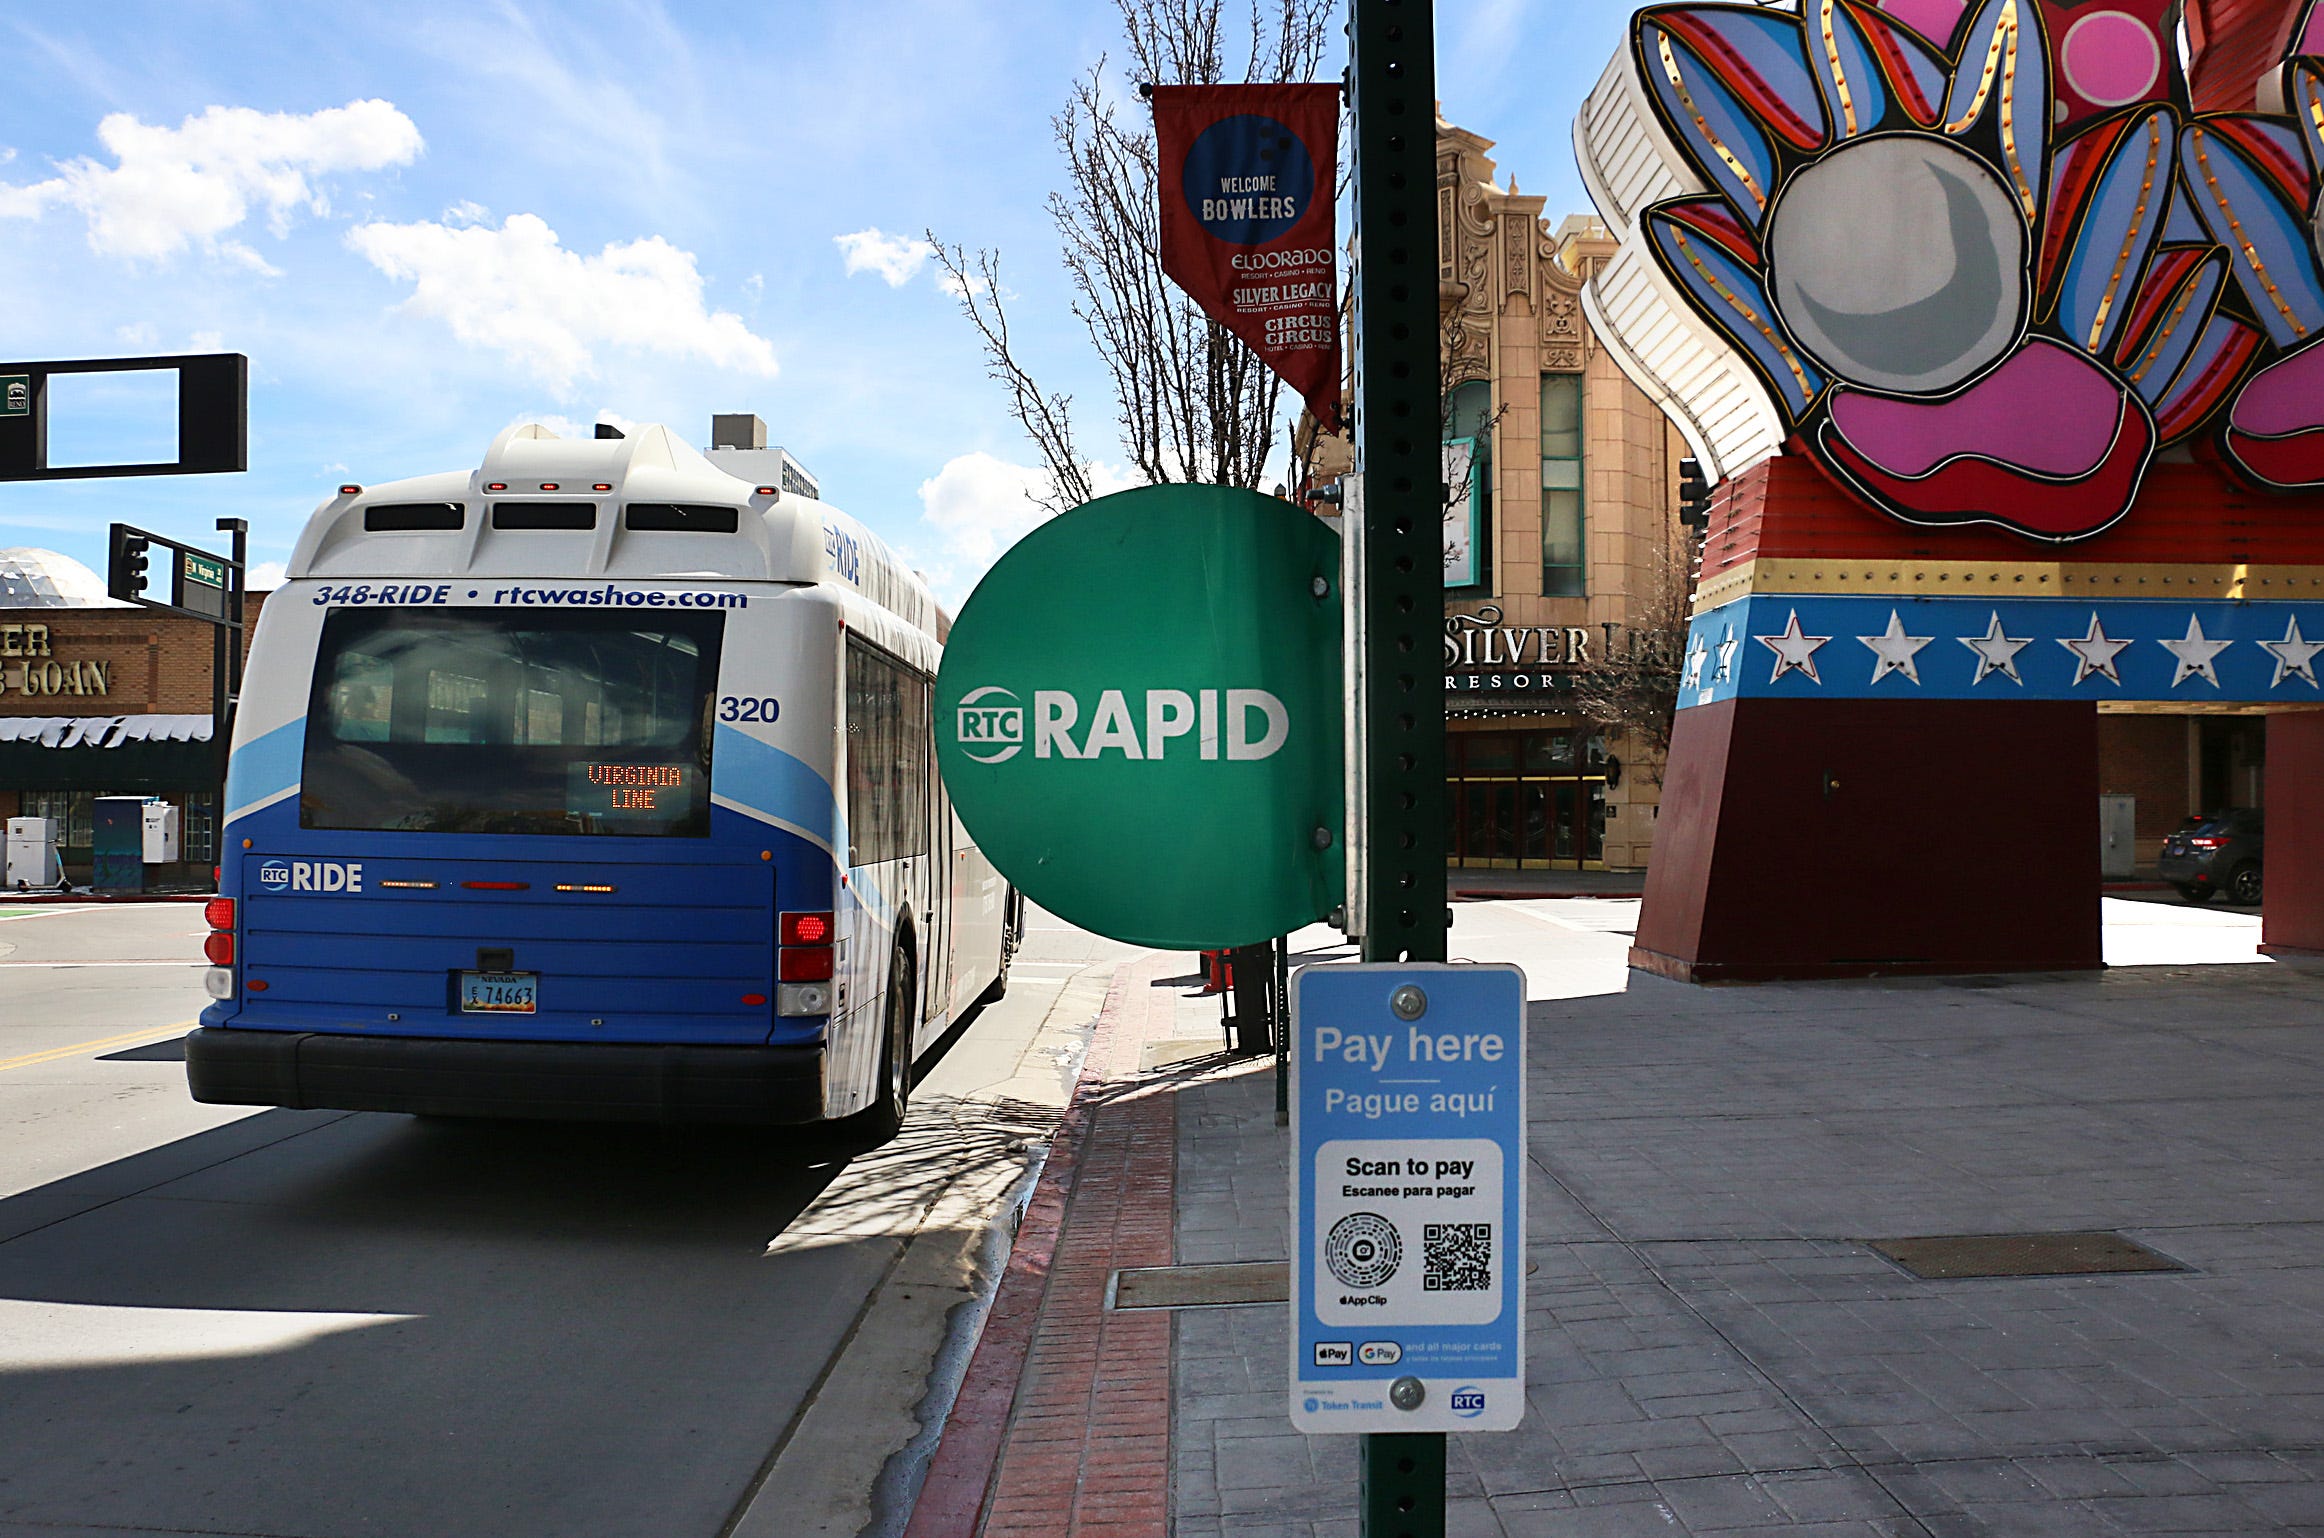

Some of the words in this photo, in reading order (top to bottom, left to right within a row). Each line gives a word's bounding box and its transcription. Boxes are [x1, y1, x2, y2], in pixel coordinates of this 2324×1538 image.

[1221, 175, 1277, 193] WELCOME
[1202, 196, 1295, 221] BOWLERS
[1274, 269, 1300, 278] CASINO
[1233, 286, 1280, 306] SILVER
[1282, 282, 1333, 302] LEGACY
[1273, 302, 1303, 311] CASINO
[1264, 315, 1332, 332] CIRCUS
[1264, 329, 1333, 345] CIRCUS
[833, 524, 859, 587] RIDE
[313, 585, 452, 606] 348-RIDE
[494, 584, 748, 609] rtcwashoe.com
[1444, 604, 1593, 668] SILVER
[19, 660, 109, 696] LOAN
[1445, 674, 1581, 690] RESORT
[719, 696, 780, 723] 320
[962, 710, 1018, 739] RTC
[1034, 688, 1289, 760] RAPID
[588, 765, 682, 786] VIRGINIA
[612, 789, 656, 808] LINE
[263, 869, 287, 881] RTC
[292, 862, 362, 892] RIDE
[481, 976, 517, 984] NEVADA
[486, 986, 532, 1004] 74663
[1315, 1027, 1392, 1072] Pay
[1409, 1027, 1504, 1061] here
[1326, 1089, 1420, 1119] Pague
[1430, 1086, 1497, 1118] aquí
[1346, 1157, 1400, 1176] Scan
[1407, 1158, 1429, 1175] to
[1435, 1160, 1474, 1180] pay
[1342, 1185, 1399, 1197] Escanee
[1403, 1187, 1433, 1199] para
[1437, 1186, 1475, 1198] pagar
[1347, 1296, 1367, 1306] App
[1368, 1295, 1387, 1306] Clip
[1328, 1348, 1347, 1360] Pay
[1377, 1348, 1396, 1360] Pay
[1405, 1343, 1425, 1352] and
[1427, 1342, 1440, 1352] all
[1442, 1341, 1471, 1353] major
[1473, 1342, 1502, 1351] cards
[1454, 1396, 1482, 1408] RTC
